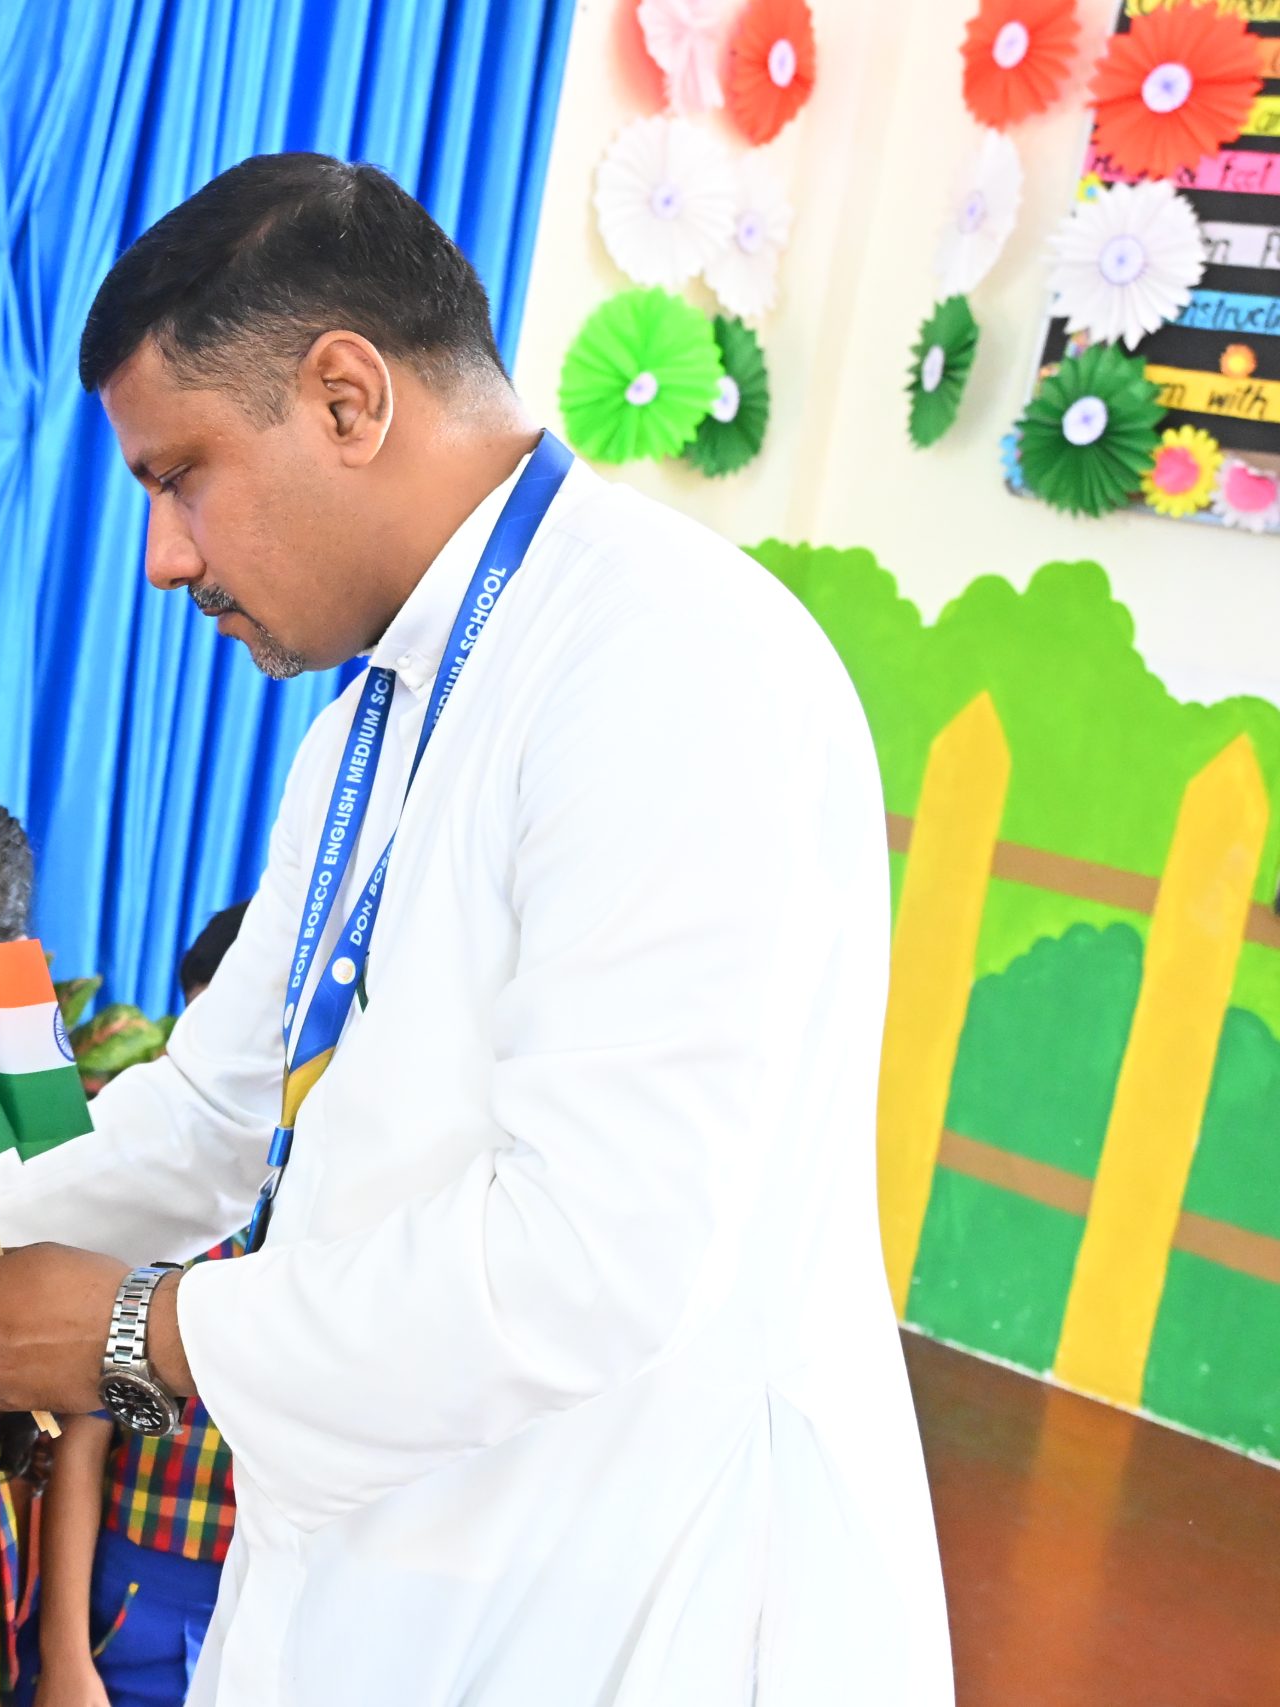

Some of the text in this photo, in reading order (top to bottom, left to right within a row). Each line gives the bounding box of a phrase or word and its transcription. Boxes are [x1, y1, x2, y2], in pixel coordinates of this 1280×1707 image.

[459, 566, 507, 653] SCHOOL
[291, 944, 311, 989] DON
[303, 870, 333, 939] BOSCO
[323, 787, 359, 866] ENGLISH
[346, 708, 382, 784] MEDIUM
[349, 900, 373, 947] DON
